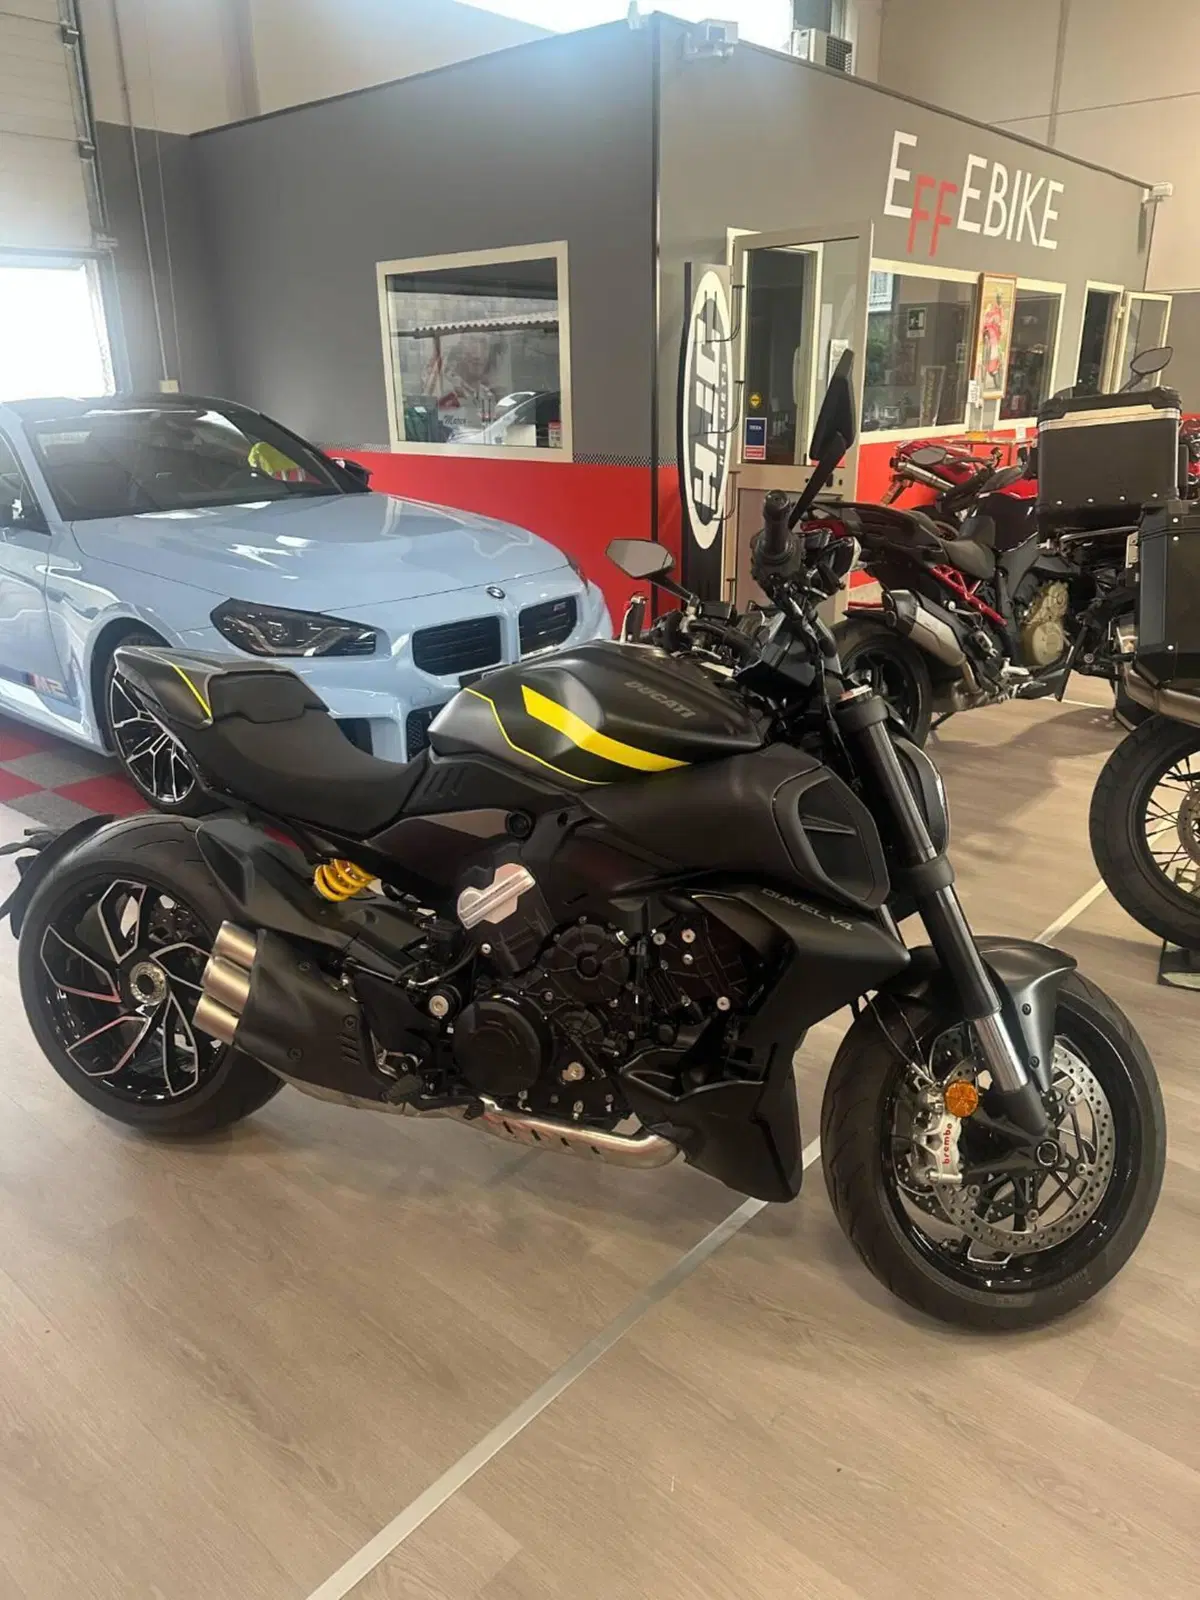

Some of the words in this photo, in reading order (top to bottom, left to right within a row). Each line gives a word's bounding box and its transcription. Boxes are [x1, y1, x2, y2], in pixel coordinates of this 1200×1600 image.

[883, 130, 1065, 257] EFFEBIKE
[694, 316, 721, 511] HJC
[718, 361, 728, 467] HELMETS
[624, 681, 696, 718] DUCATI
[762, 888, 828, 920] DIAVEL
[829, 915, 853, 931] V4
[942, 1123, 953, 1165] brembo
